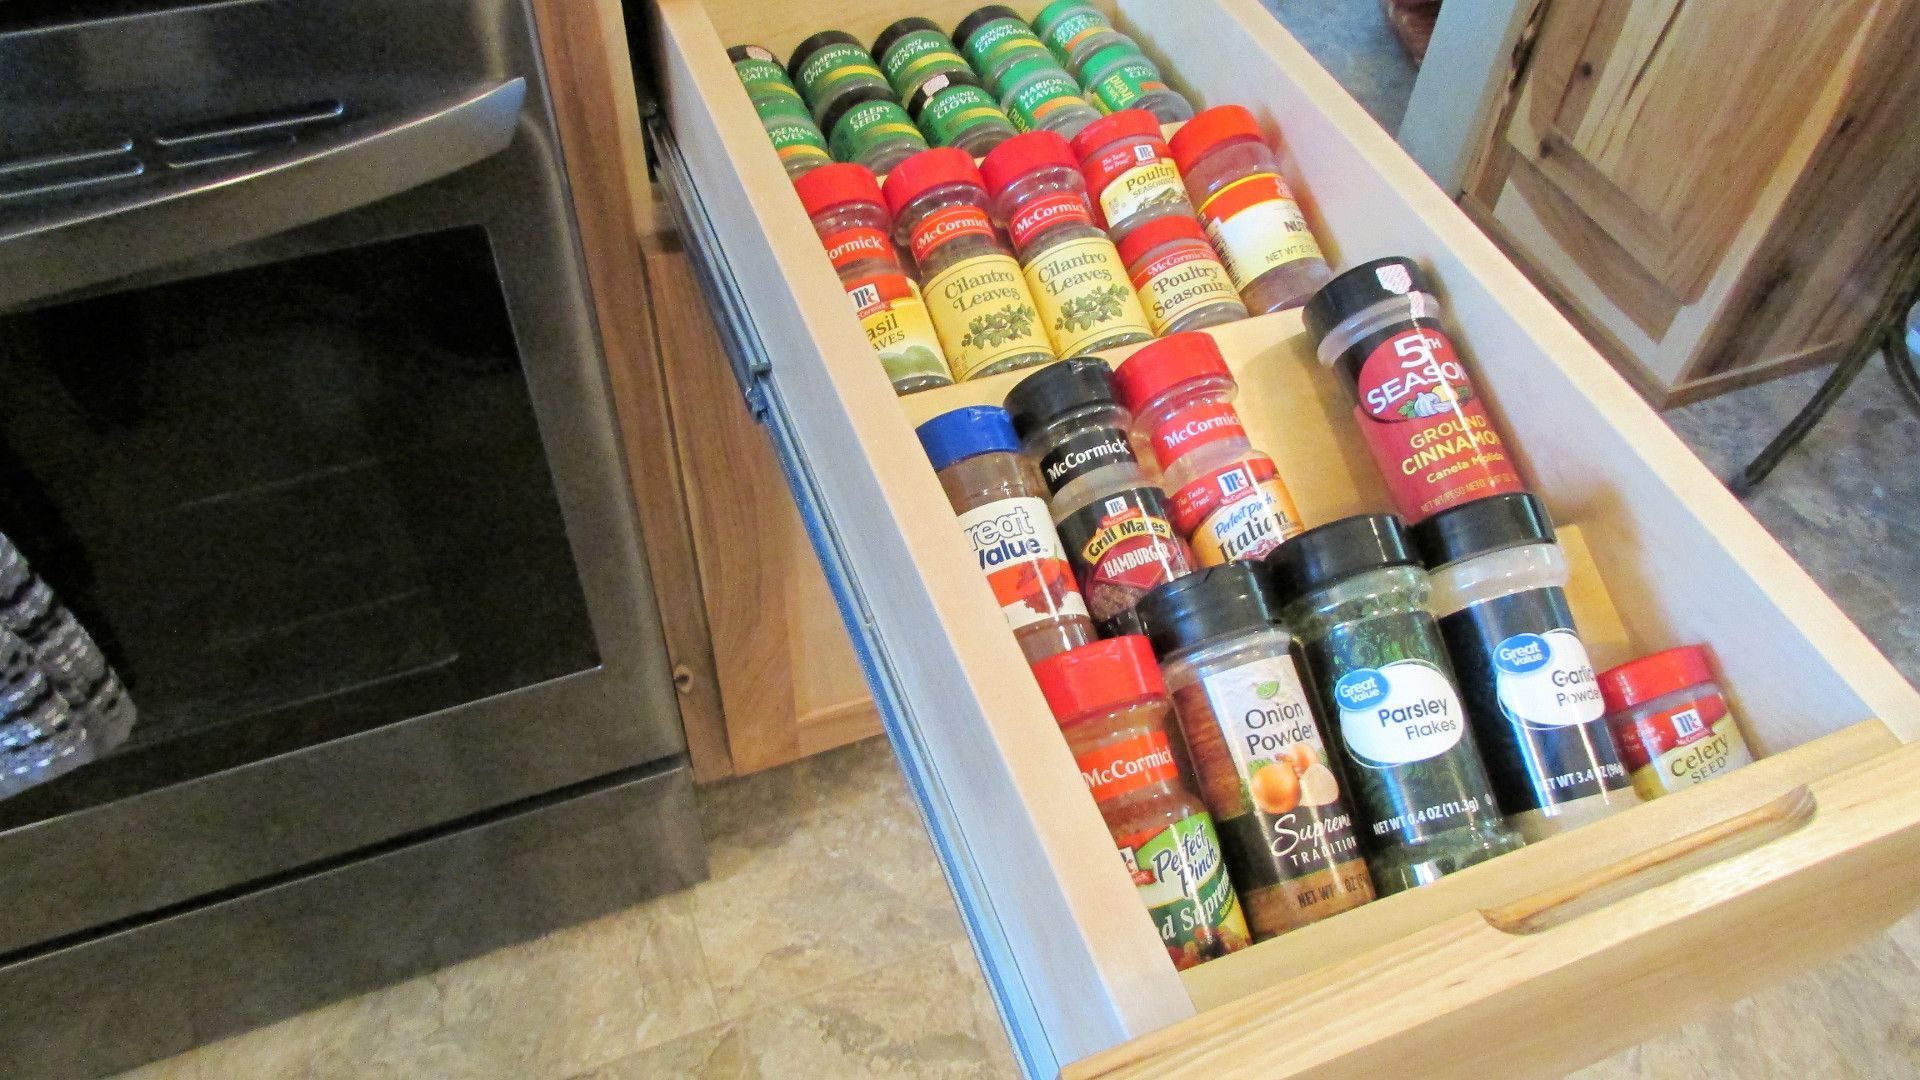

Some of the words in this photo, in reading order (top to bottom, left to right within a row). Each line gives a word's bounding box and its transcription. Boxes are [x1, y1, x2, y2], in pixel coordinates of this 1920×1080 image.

[932, 90, 975, 113] GROUND
[936, 95, 981, 119] CLOVES
[1024, 84, 1063, 110] LEAVES
[849, 104, 891, 125] CELERY
[852, 113, 881, 133] SEED
[1126, 162, 1176, 191] Poultry
[827, 234, 886, 260] ormick
[1037, 251, 1107, 284] Cilantro
[1045, 266, 1113, 298] Leaves
[1152, 265, 1219, 295] Poultry
[943, 269, 1015, 301] Cilantro
[1152, 278, 1230, 319] Seasonin
[952, 286, 1021, 314] Leaves
[865, 312, 900, 341] asil
[872, 330, 906, 352] AVES
[1409, 414, 1487, 449] GROUND
[1046, 438, 1131, 483] McCormick
[1426, 460, 1470, 484] Canela
[964, 506, 1035, 551] reat
[1214, 505, 1247, 540] Perfect
[1246, 491, 1273, 519] Pinh
[1087, 527, 1117, 557] Grill
[1103, 542, 1172, 579] HAMBURGR
[1499, 640, 1541, 662] Great
[1340, 675, 1379, 699] Great
[1555, 688, 1602, 707] Powde
[1245, 702, 1305, 731] Onion
[1377, 697, 1448, 728] Parsley
[1405, 718, 1457, 741] Flakes
[1670, 733, 1729, 777] Celery
[1555, 772, 1576, 788] WT
[1575, 768, 1594, 784] 3.4
[1690, 756, 1727, 784] SEED
[1372, 819, 1390, 836] NET
[1388, 814, 1406, 831] WT
[1406, 810, 1427, 826] 0.4
[1426, 805, 1444, 821] OZ
[1442, 796, 1479, 818] (11.3g)
[1270, 813, 1352, 858] Suprem
[1152, 822, 1207, 884] Pefect
[1180, 861, 1231, 932] Suprem
[1297, 888, 1318, 909] NET
